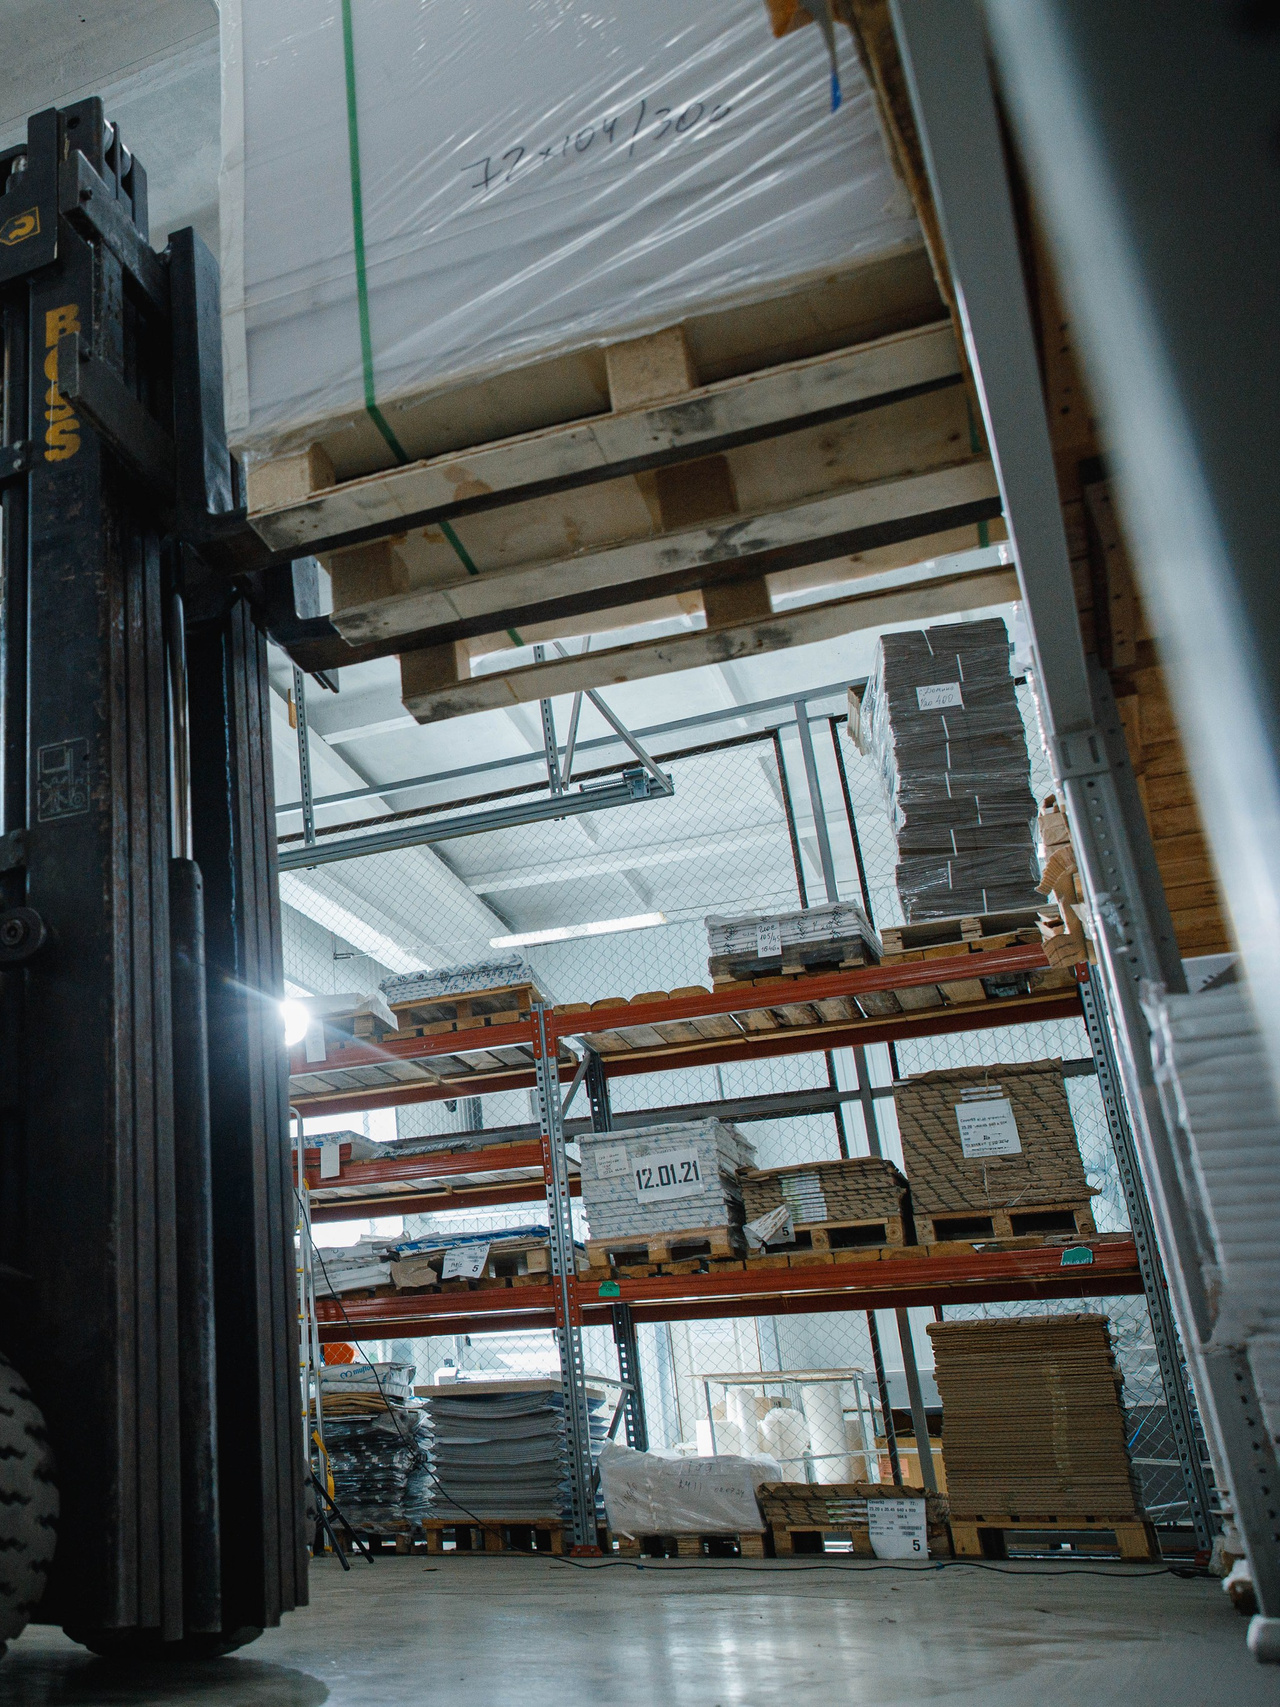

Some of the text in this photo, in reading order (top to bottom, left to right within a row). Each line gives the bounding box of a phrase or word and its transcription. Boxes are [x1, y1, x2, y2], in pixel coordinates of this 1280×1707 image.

[635, 1160, 700, 1190] 12.01.21
[781, 1226, 790, 1237] 5
[471, 1264, 480, 1273] 5
[912, 1539, 921, 1552] 5
